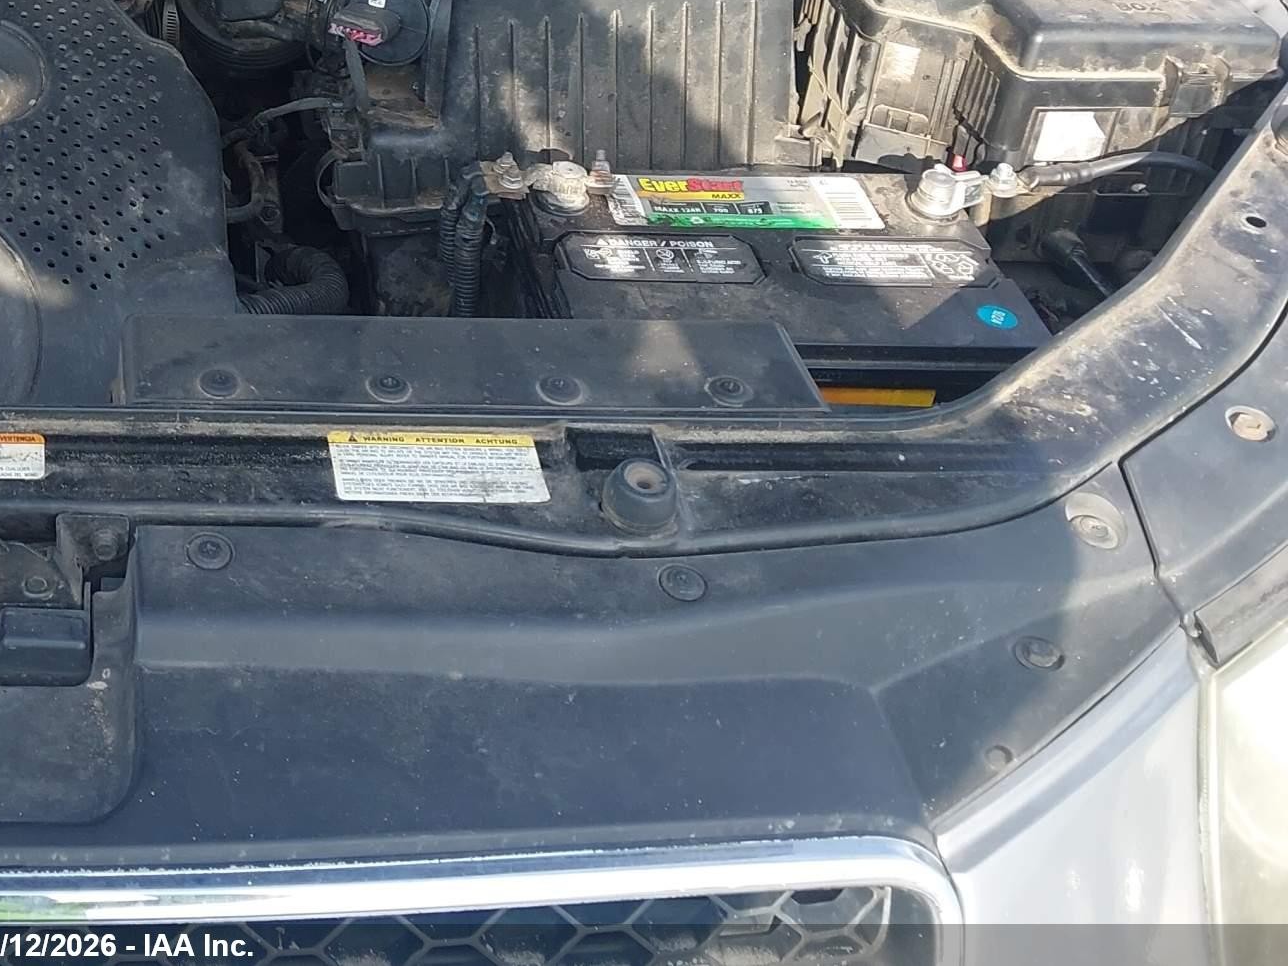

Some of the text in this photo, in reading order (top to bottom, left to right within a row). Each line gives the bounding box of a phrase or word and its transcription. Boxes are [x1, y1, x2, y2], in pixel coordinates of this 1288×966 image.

[1112, 1, 1163, 13] BOX
[637, 177, 744, 193] EverStart
[610, 238, 658, 248] DANGER
[669, 240, 715, 249] POISON
[362, 435, 405, 443] WARNING
